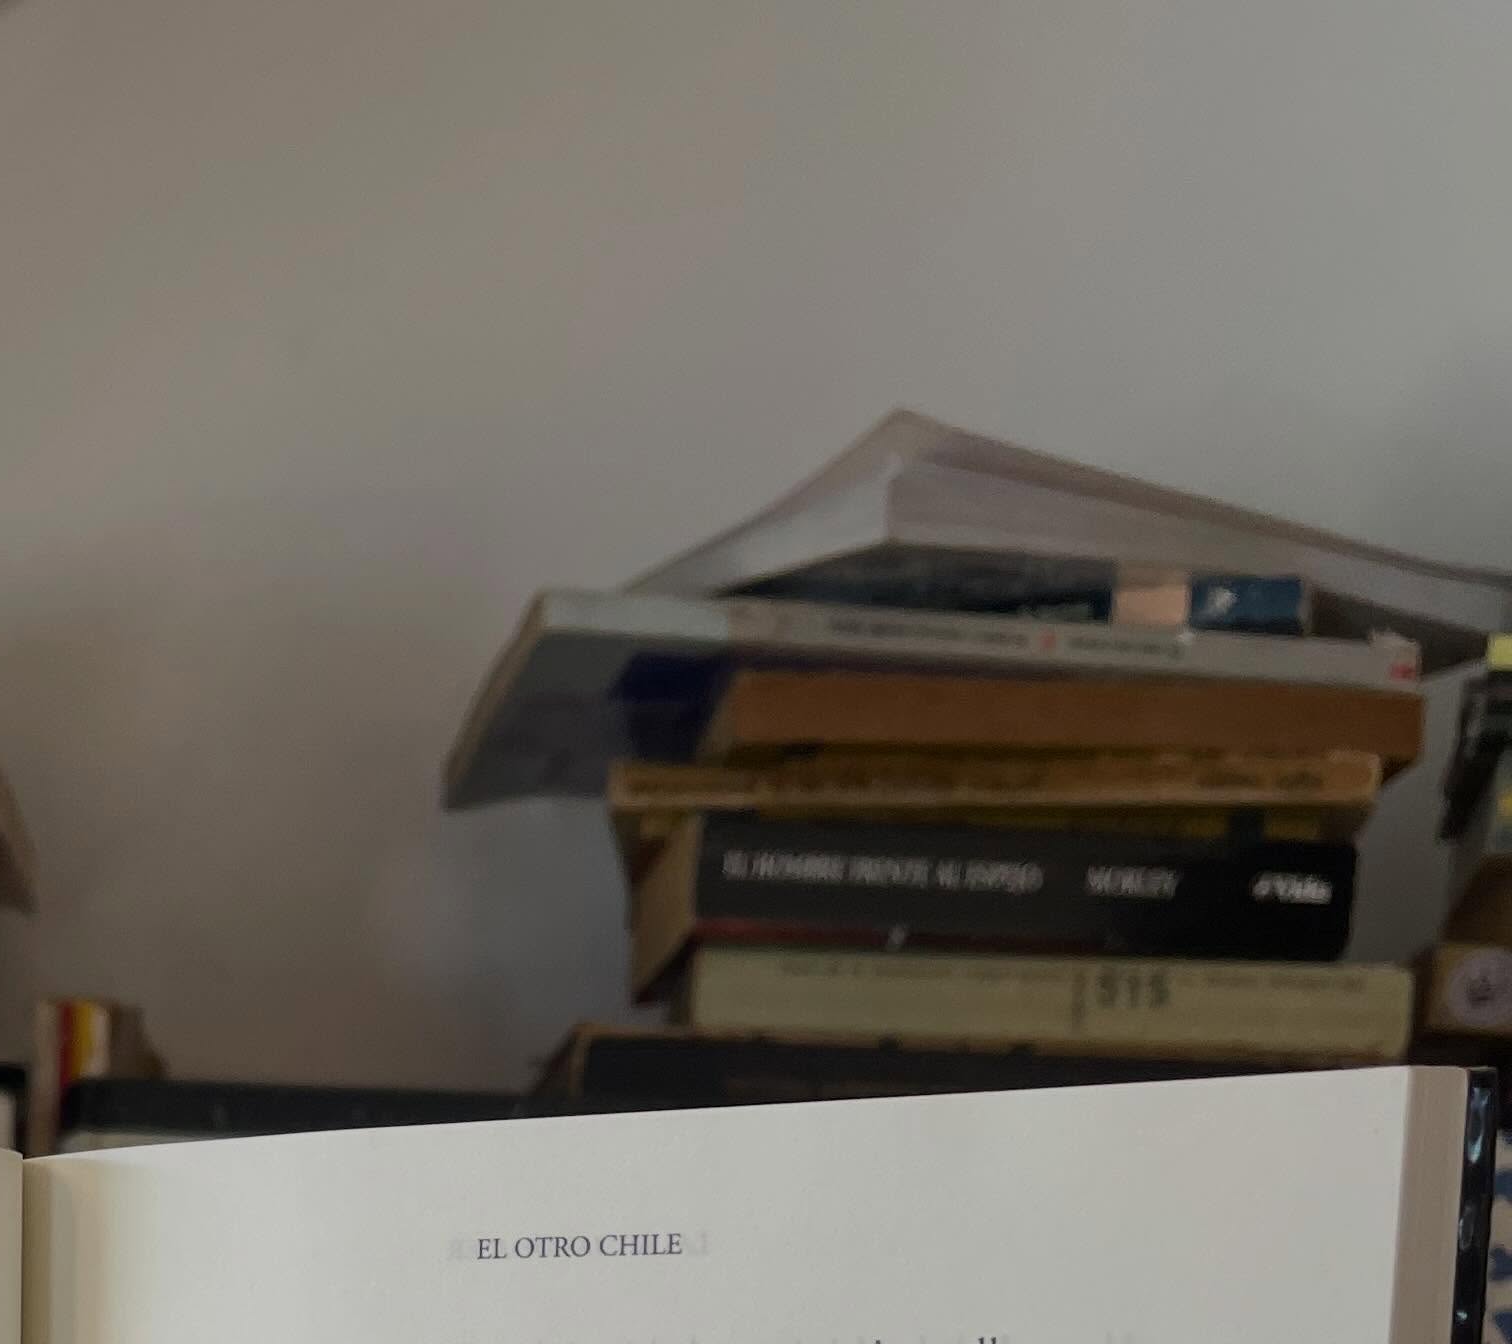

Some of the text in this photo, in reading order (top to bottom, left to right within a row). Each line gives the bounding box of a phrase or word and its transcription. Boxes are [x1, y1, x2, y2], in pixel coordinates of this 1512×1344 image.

[475, 1232, 684, 1261] EL OTRO CHILE
